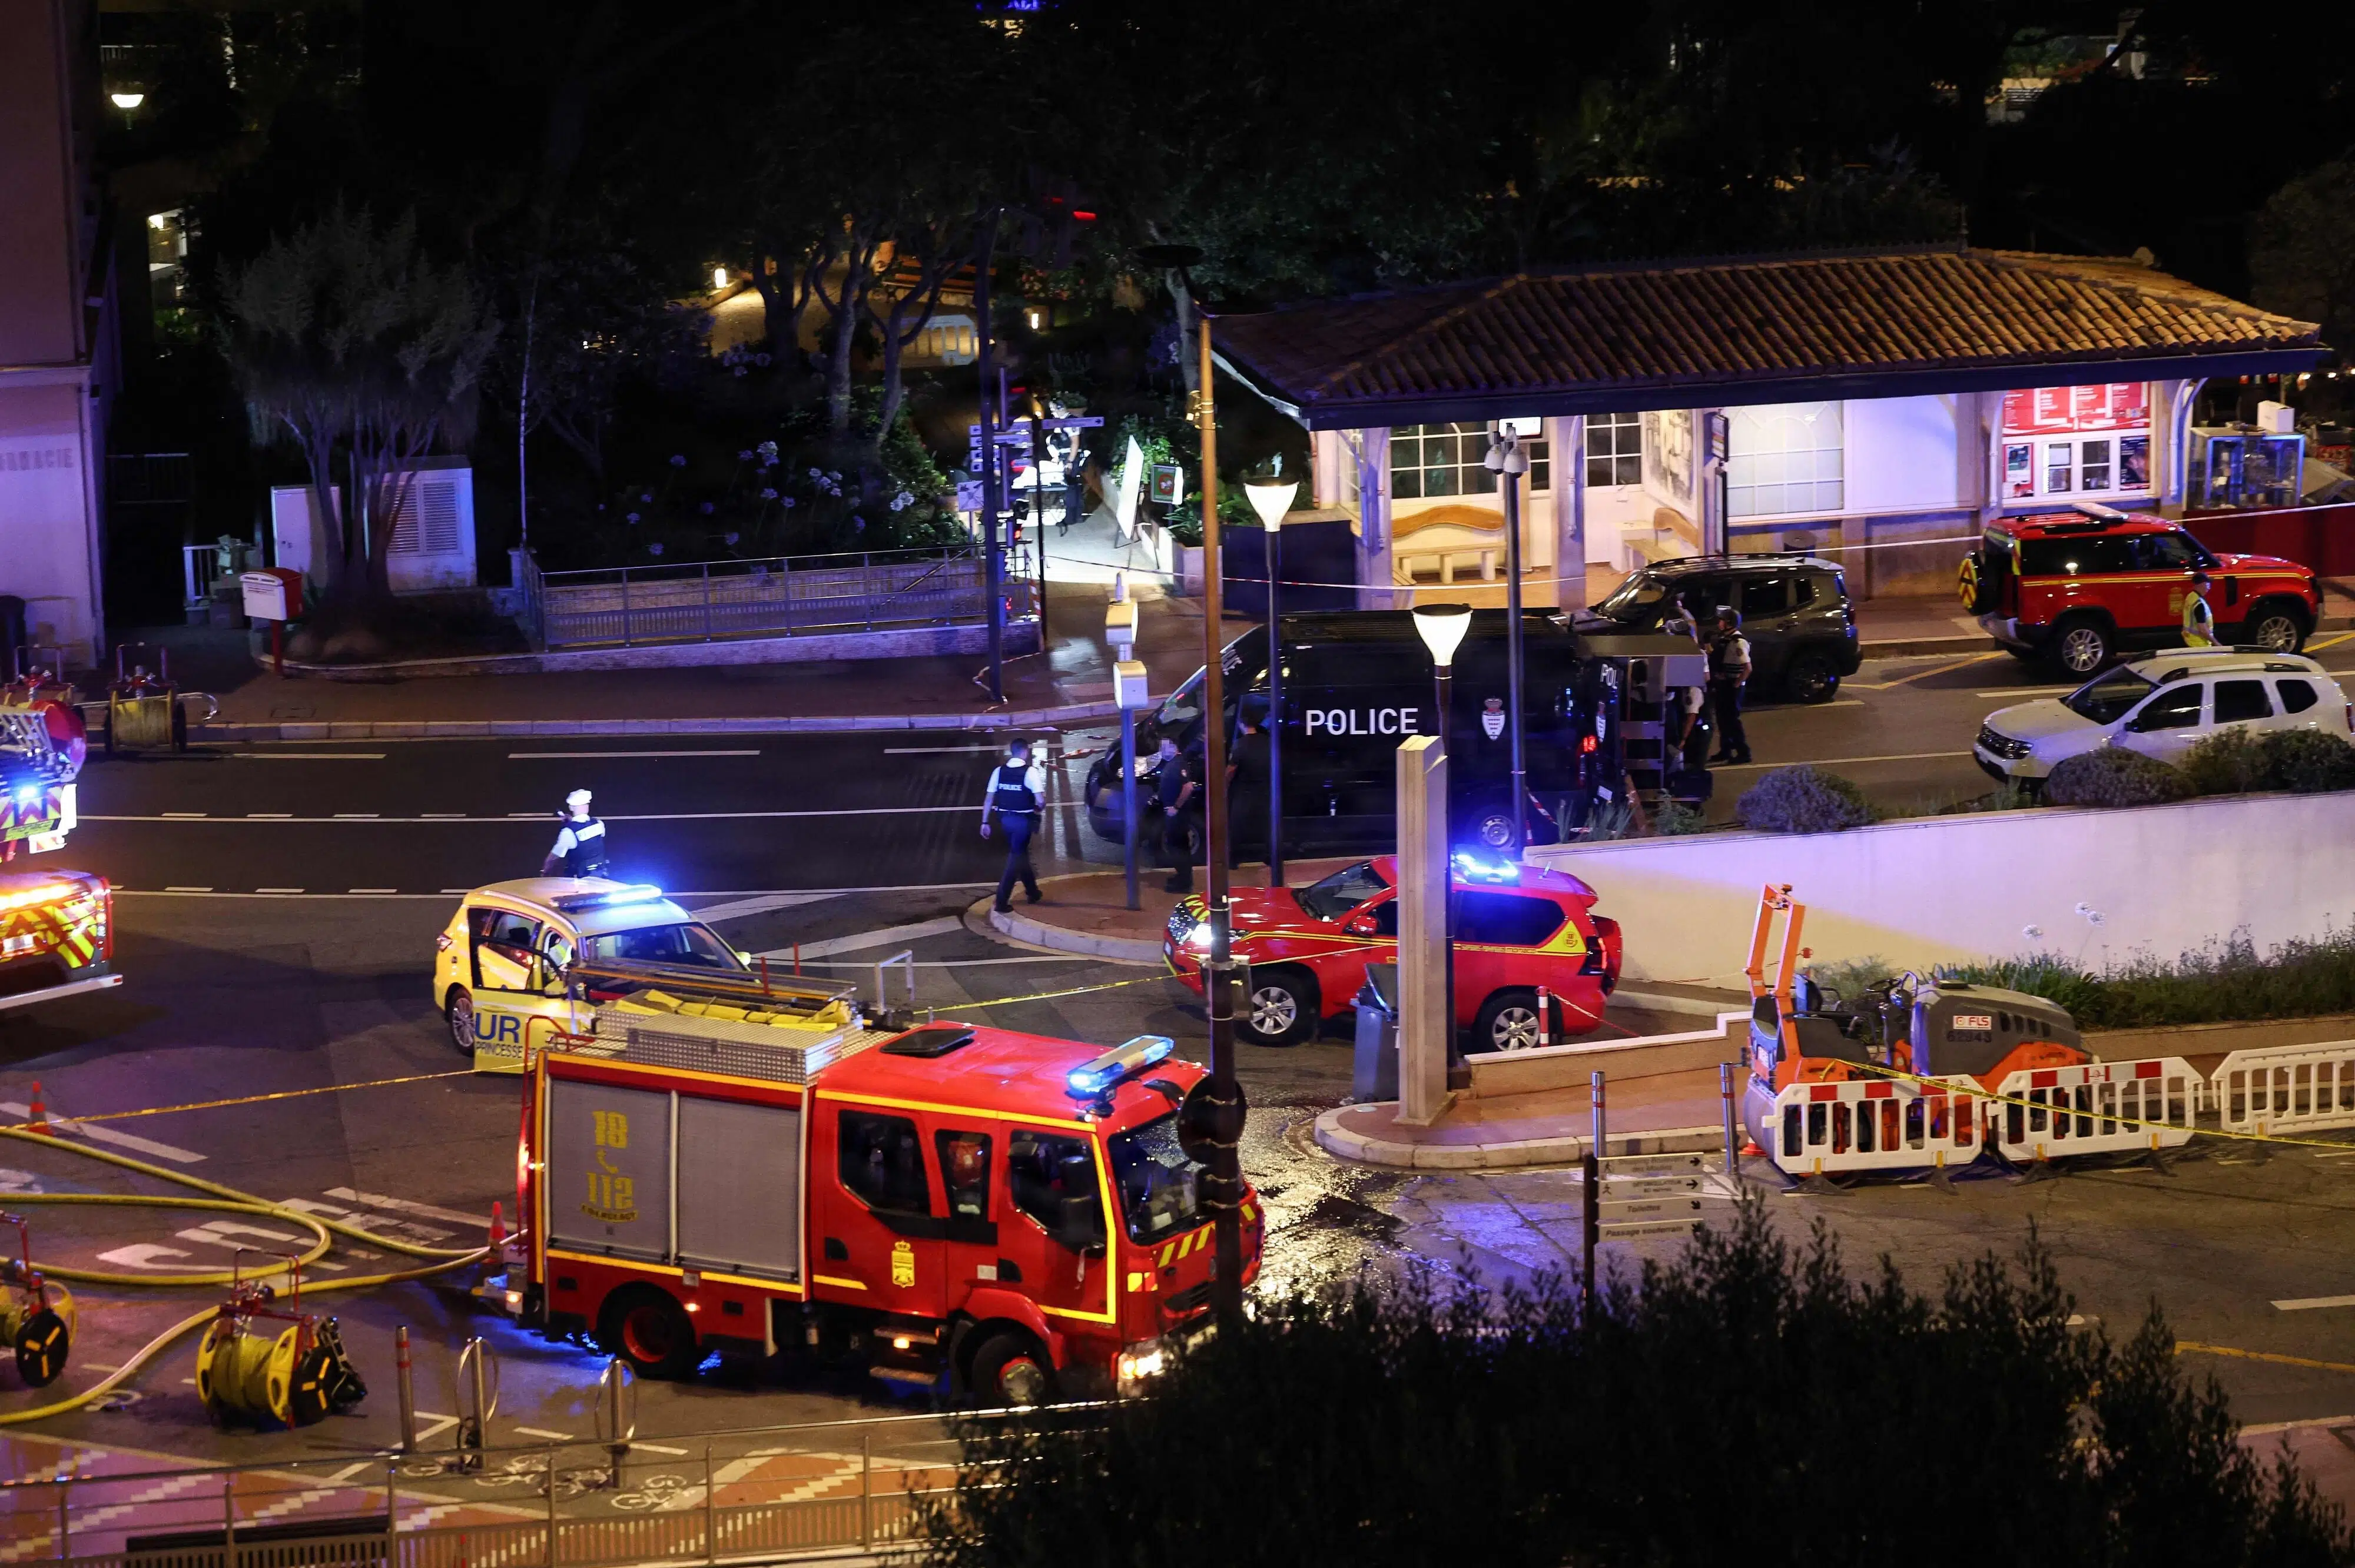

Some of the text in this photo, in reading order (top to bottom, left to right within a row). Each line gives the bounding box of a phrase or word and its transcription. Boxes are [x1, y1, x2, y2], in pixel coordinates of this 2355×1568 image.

[1600, 663, 1617, 689] POL
[1306, 708, 1418, 735] POLICE
[475, 1012, 520, 1043] UR
[1969, 1016, 1989, 1026] FLS
[476, 1041, 523, 1058] PRINCESSE
[593, 1111, 626, 1148] 18
[586, 1172, 633, 1210] 112
[1606, 1226, 1684, 1237] Passage souterrain
